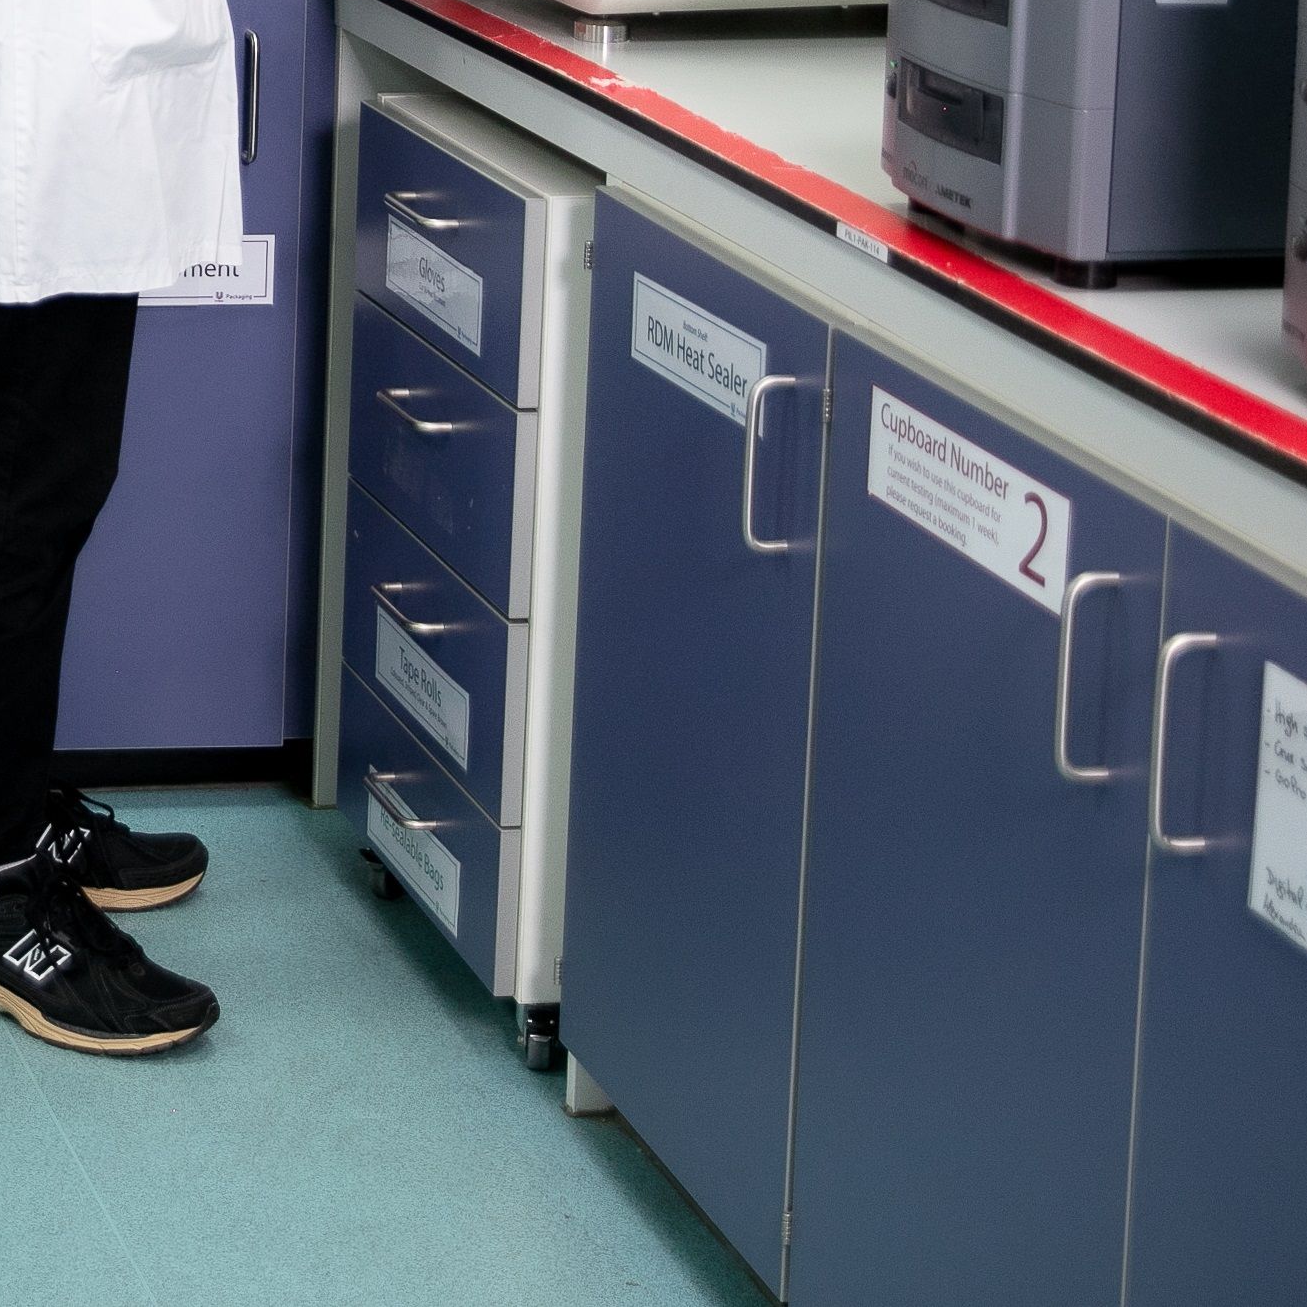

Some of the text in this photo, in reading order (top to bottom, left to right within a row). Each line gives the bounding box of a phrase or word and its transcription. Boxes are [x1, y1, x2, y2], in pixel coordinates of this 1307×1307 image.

[936, 183, 972, 209] AMETEK
[844, 228, 880, 255] PIL1-PAK-114
[419, 257, 445, 293] Gloves
[647, 315, 748, 398] RDM Heat Sealer
[697, 328, 708, 342] Shelf
[881, 402, 1048, 588] Cupboard Number 2
[886, 484, 907, 508] please
[907, 497, 932, 525] request
[887, 466, 910, 487] current
[910, 480, 934, 506] testing
[935, 493, 971, 526] (maximum
[893, 449, 906, 465] you
[907, 453, 922, 472] wish
[922, 465, 931, 479] to
[930, 471, 943, 487] use
[943, 475, 956, 494] this
[956, 485, 991, 517] cupboard
[991, 506, 1001, 524] for
[399, 645, 442, 708] Tape Rolls
[380, 805, 444, 891] Re-sealable Bags
